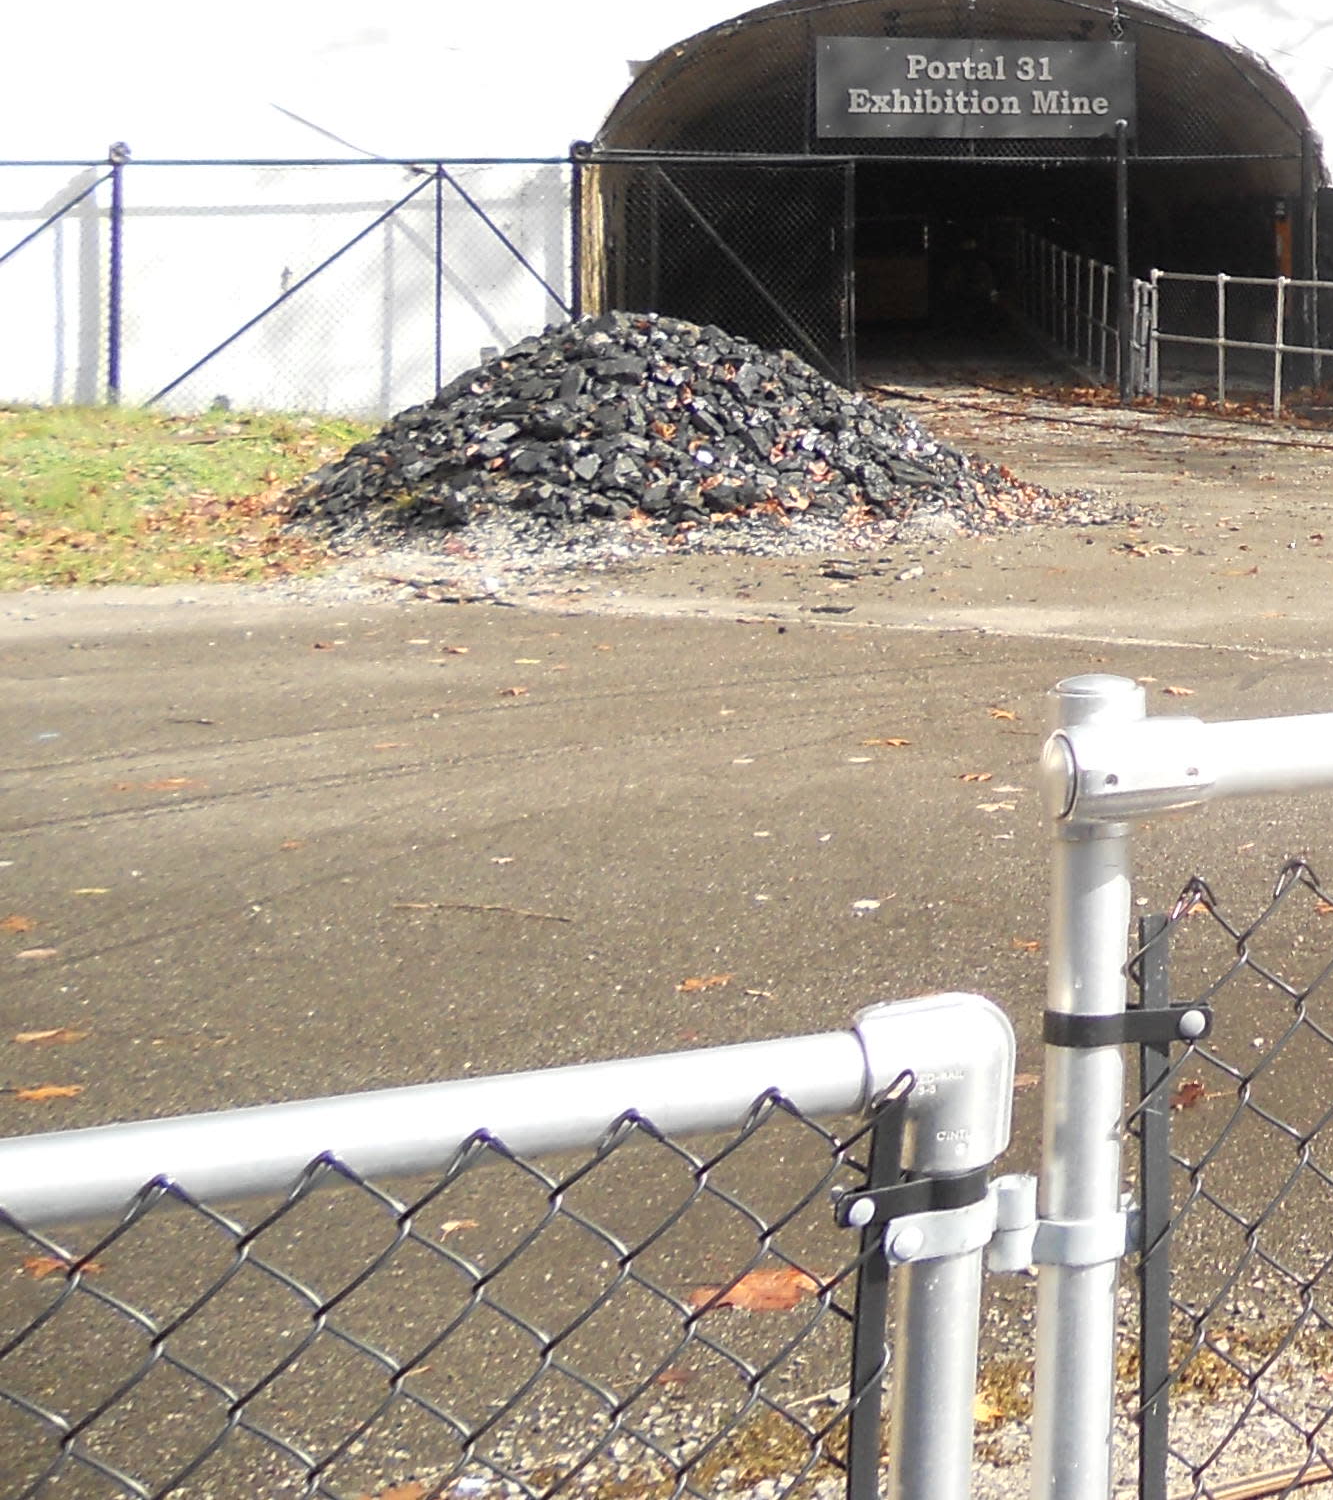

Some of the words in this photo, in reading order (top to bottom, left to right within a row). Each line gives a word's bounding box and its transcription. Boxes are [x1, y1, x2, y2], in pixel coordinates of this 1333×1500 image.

[906, 54, 1006, 80] Portal
[1016, 56, 1054, 81] 31
[848, 88, 1022, 115] Exhibition
[1032, 90, 1110, 115] Mine
